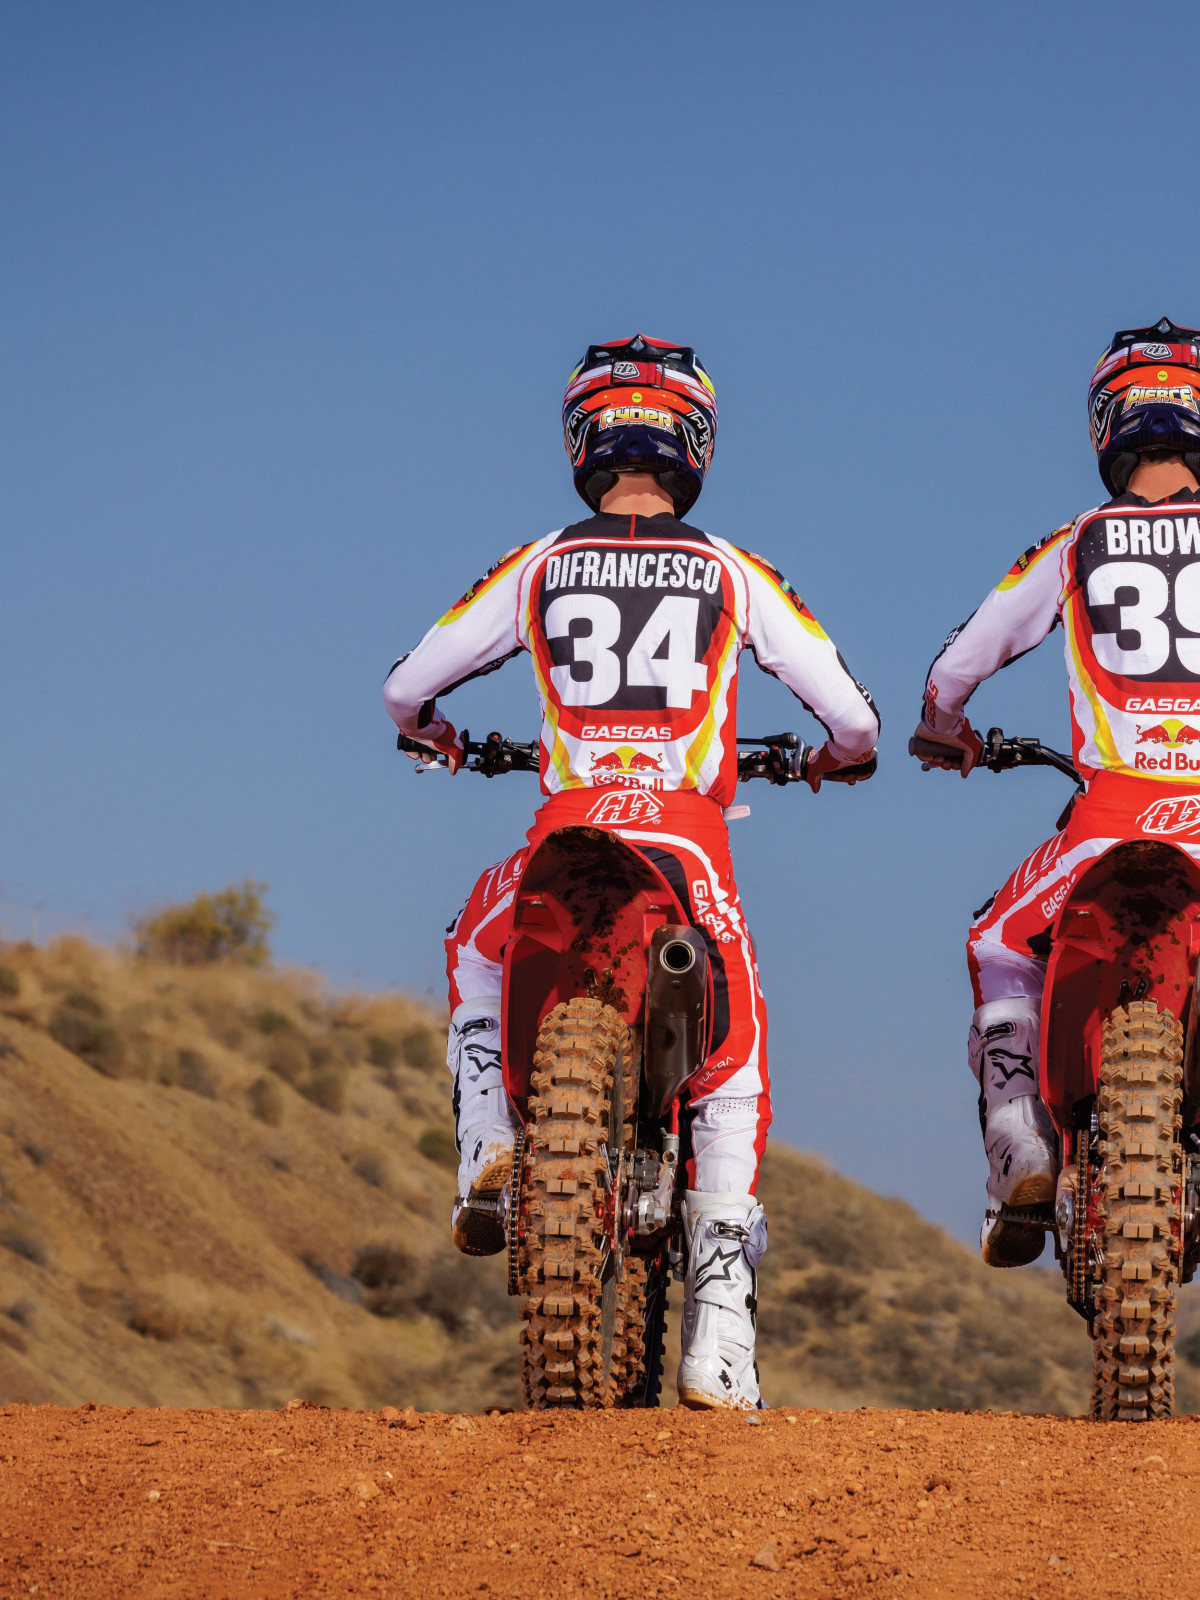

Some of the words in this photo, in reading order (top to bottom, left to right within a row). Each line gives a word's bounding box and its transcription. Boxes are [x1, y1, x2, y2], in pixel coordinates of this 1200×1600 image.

[1124, 387, 1196, 411] PIERCE
[545, 551, 722, 594] DIFRANCESCO
[544, 593, 709, 710] 34
[581, 726, 672, 740] GASGAS
[1134, 752, 1173, 771] Red
